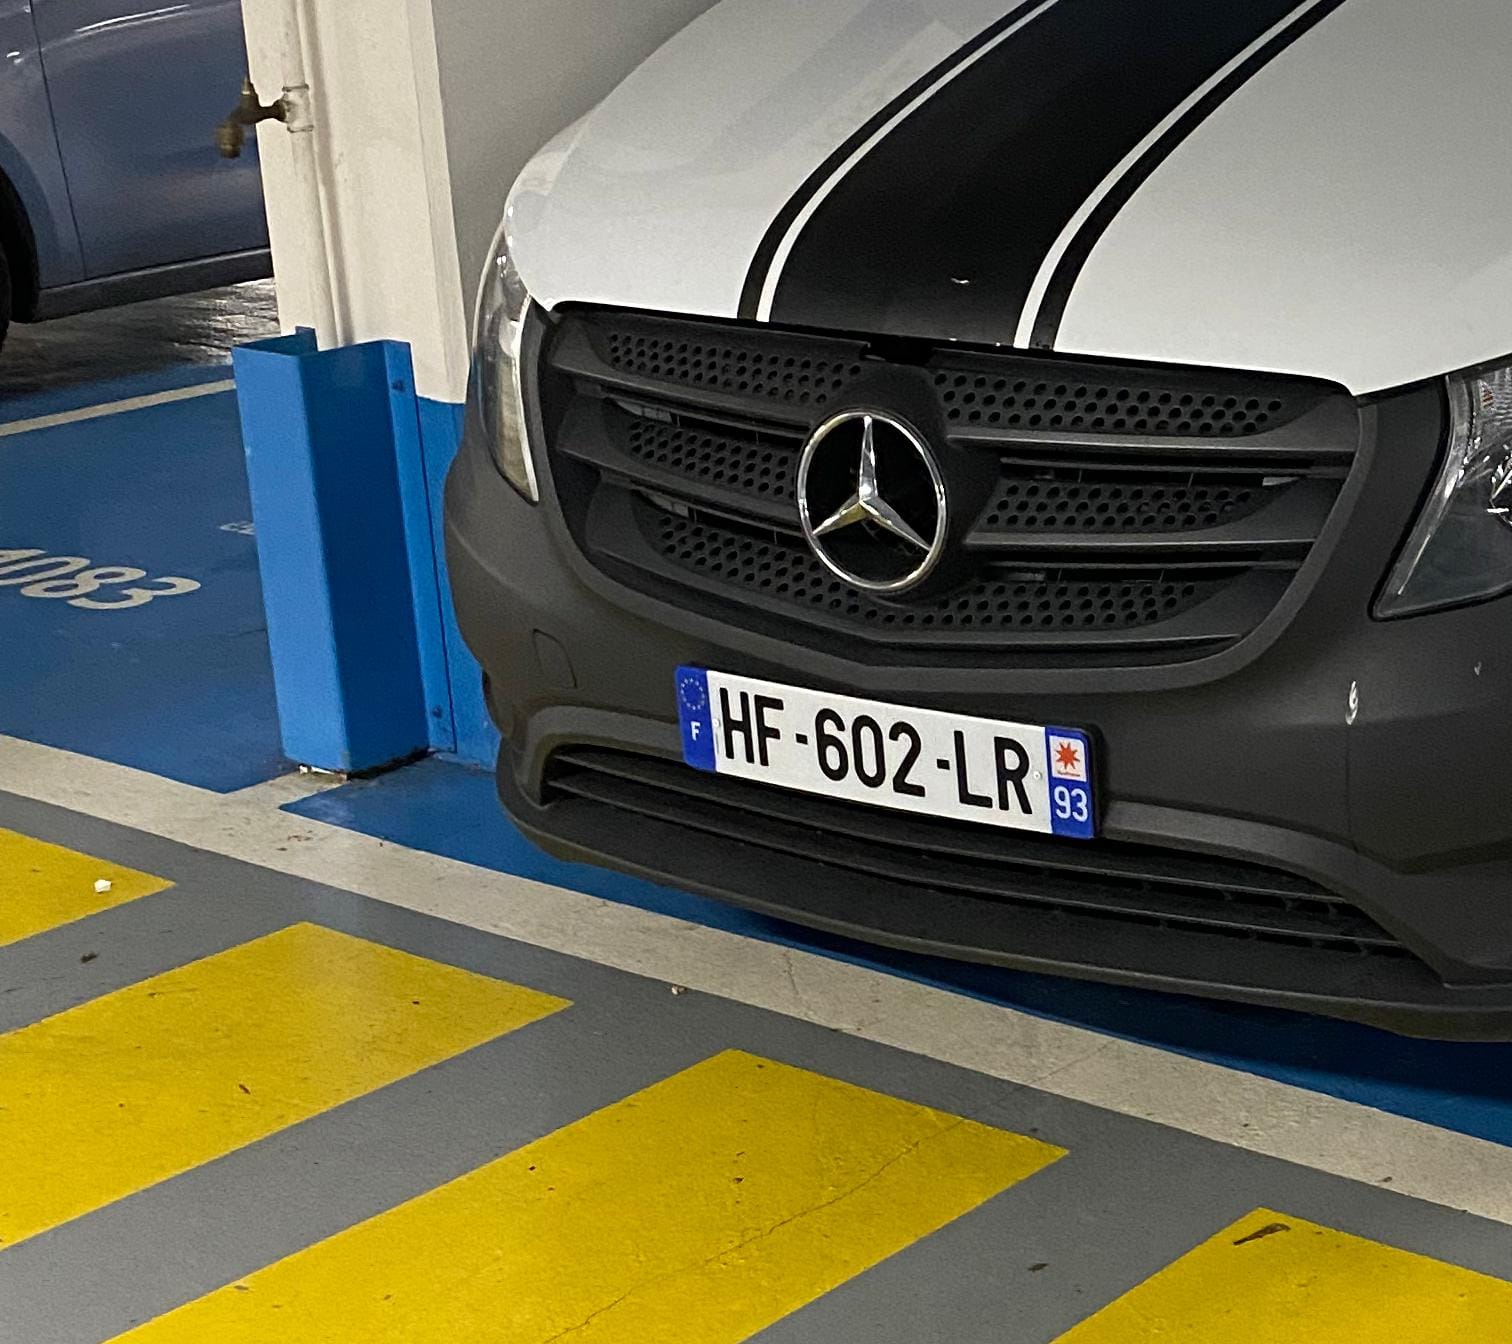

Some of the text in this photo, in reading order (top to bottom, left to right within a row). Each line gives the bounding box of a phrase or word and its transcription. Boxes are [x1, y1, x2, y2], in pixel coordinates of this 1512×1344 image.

[690, 721, 702, 743] F
[719, 687, 1033, 815] HF-602-LR
[1054, 785, 1088, 822] 93
